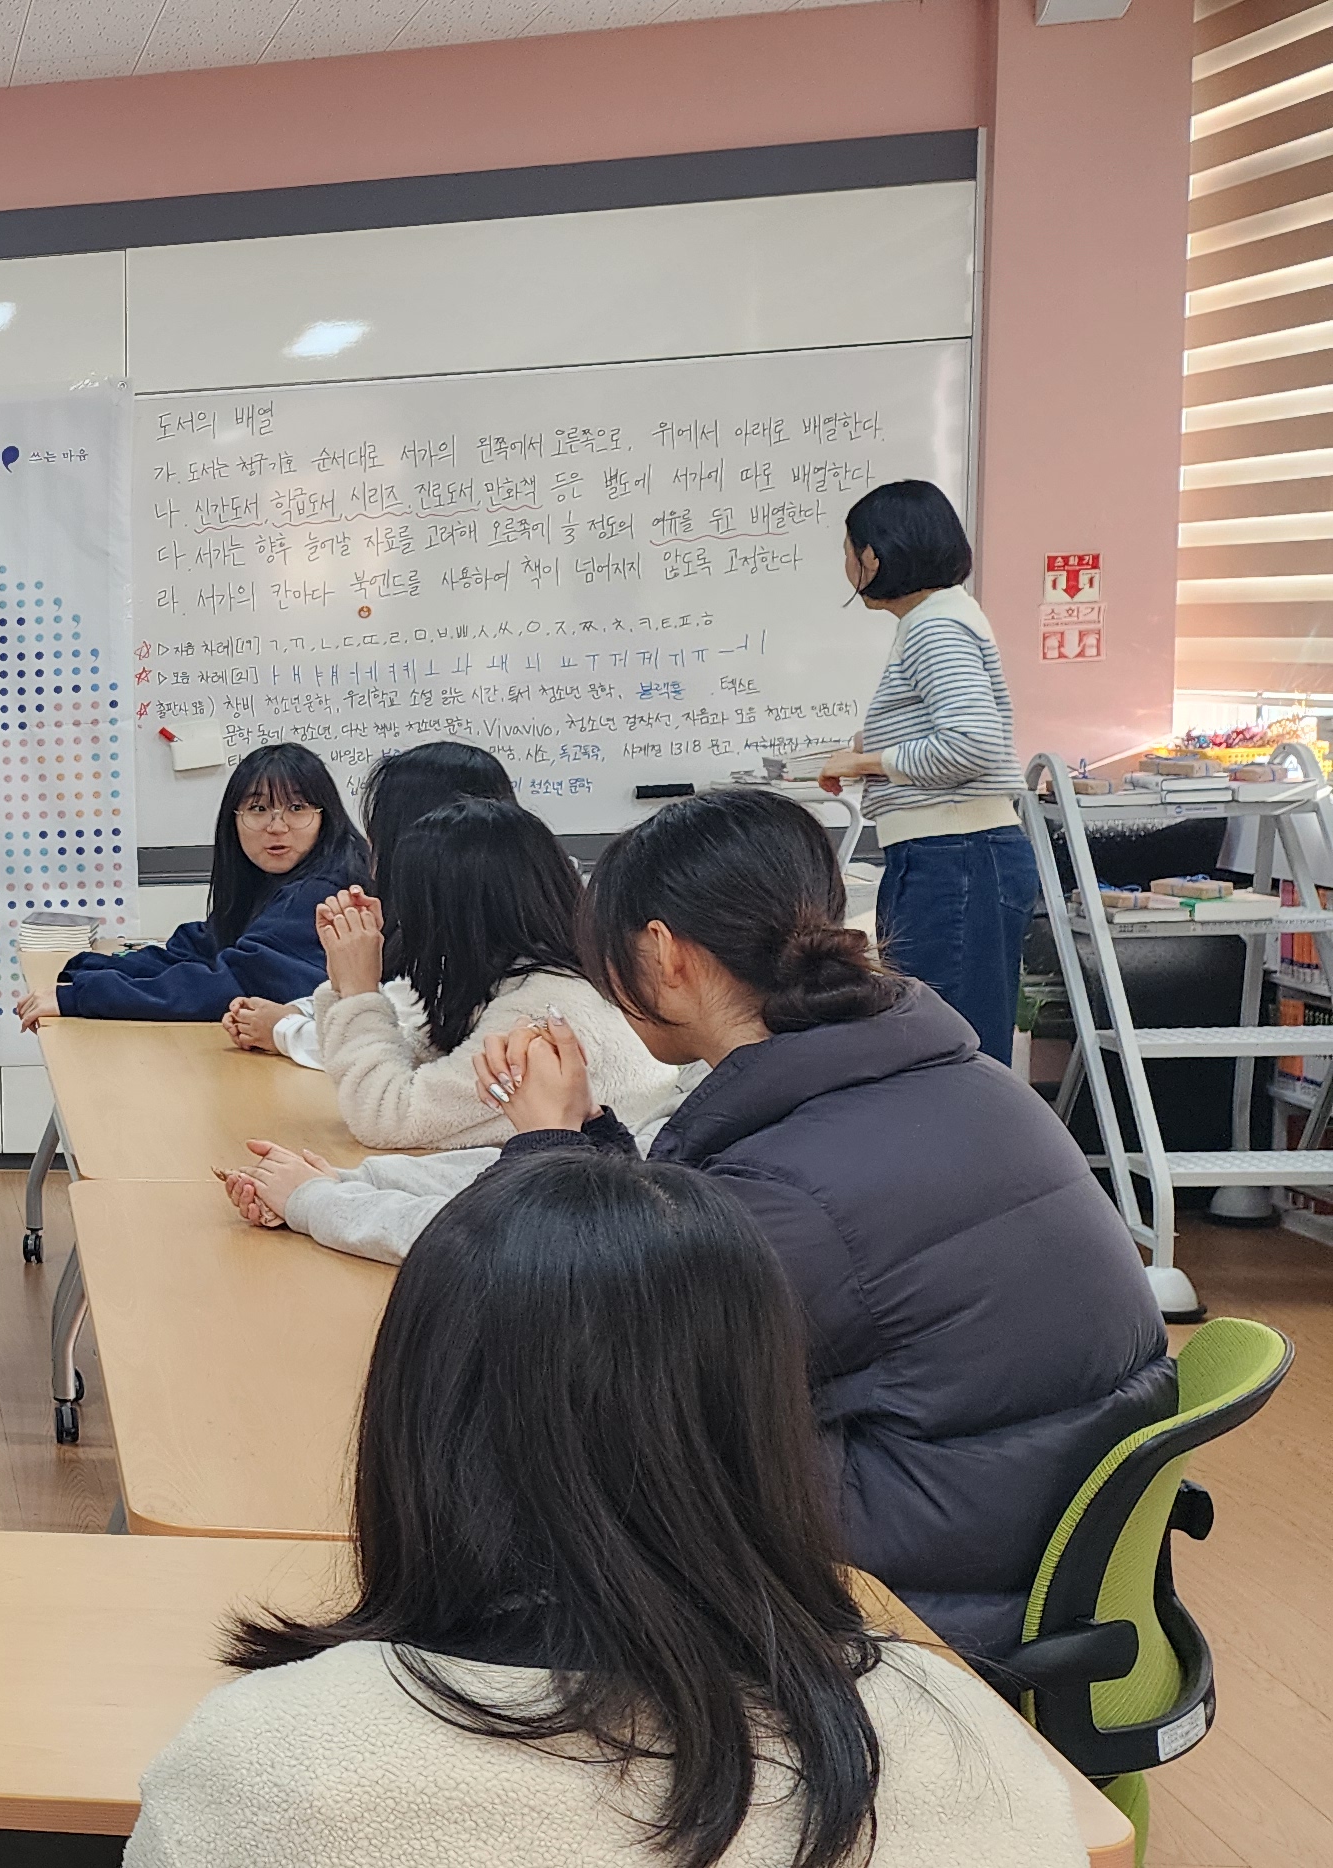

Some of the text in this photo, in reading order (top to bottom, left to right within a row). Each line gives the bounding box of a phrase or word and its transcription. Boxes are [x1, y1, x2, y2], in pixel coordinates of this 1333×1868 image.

[156, 401, 274, 441] 도서의 배열
[154, 462, 181, 484] 가.
[188, 457, 230, 483] 도서는
[311, 440, 384, 473] 순서대로
[400, 435, 456, 468] 서가의
[477, 431, 544, 464] 왼쪽에서
[652, 419, 719, 449] 위에서
[734, 417, 790, 445] 아래로
[486, 475, 538, 506] 만화책
[550, 472, 584, 504] 등은
[673, 459, 724, 492] 서가에
[740, 462, 775, 492] 따로
[157, 540, 192, 572] 다.
[195, 536, 246, 568] 서가는
[255, 532, 292, 566] 향후
[303, 531, 351, 562] 늘어날
[425, 521, 479, 550] 고려해
[487, 510, 552, 548] 오른쪽에
[587, 510, 634, 541] 정도의
[651, 507, 693, 537] 여유를
[709, 506, 735, 534] 두고
[197, 582, 256, 615] 서가의
[270, 579, 335, 610] 칸마다
[441, 560, 510, 592] 사용하여
[522, 554, 560, 588] 책이
[575, 551, 642, 585] 넘어지지
[663, 547, 712, 581] 않도록
[723, 544, 804, 576] 고정한다
[223, 694, 256, 719] 창비
[409, 688, 434, 708] 소설
[539, 682, 582, 704] 청소년
[565, 712, 618, 734] 청소년
[669, 740, 702, 756] 1318
